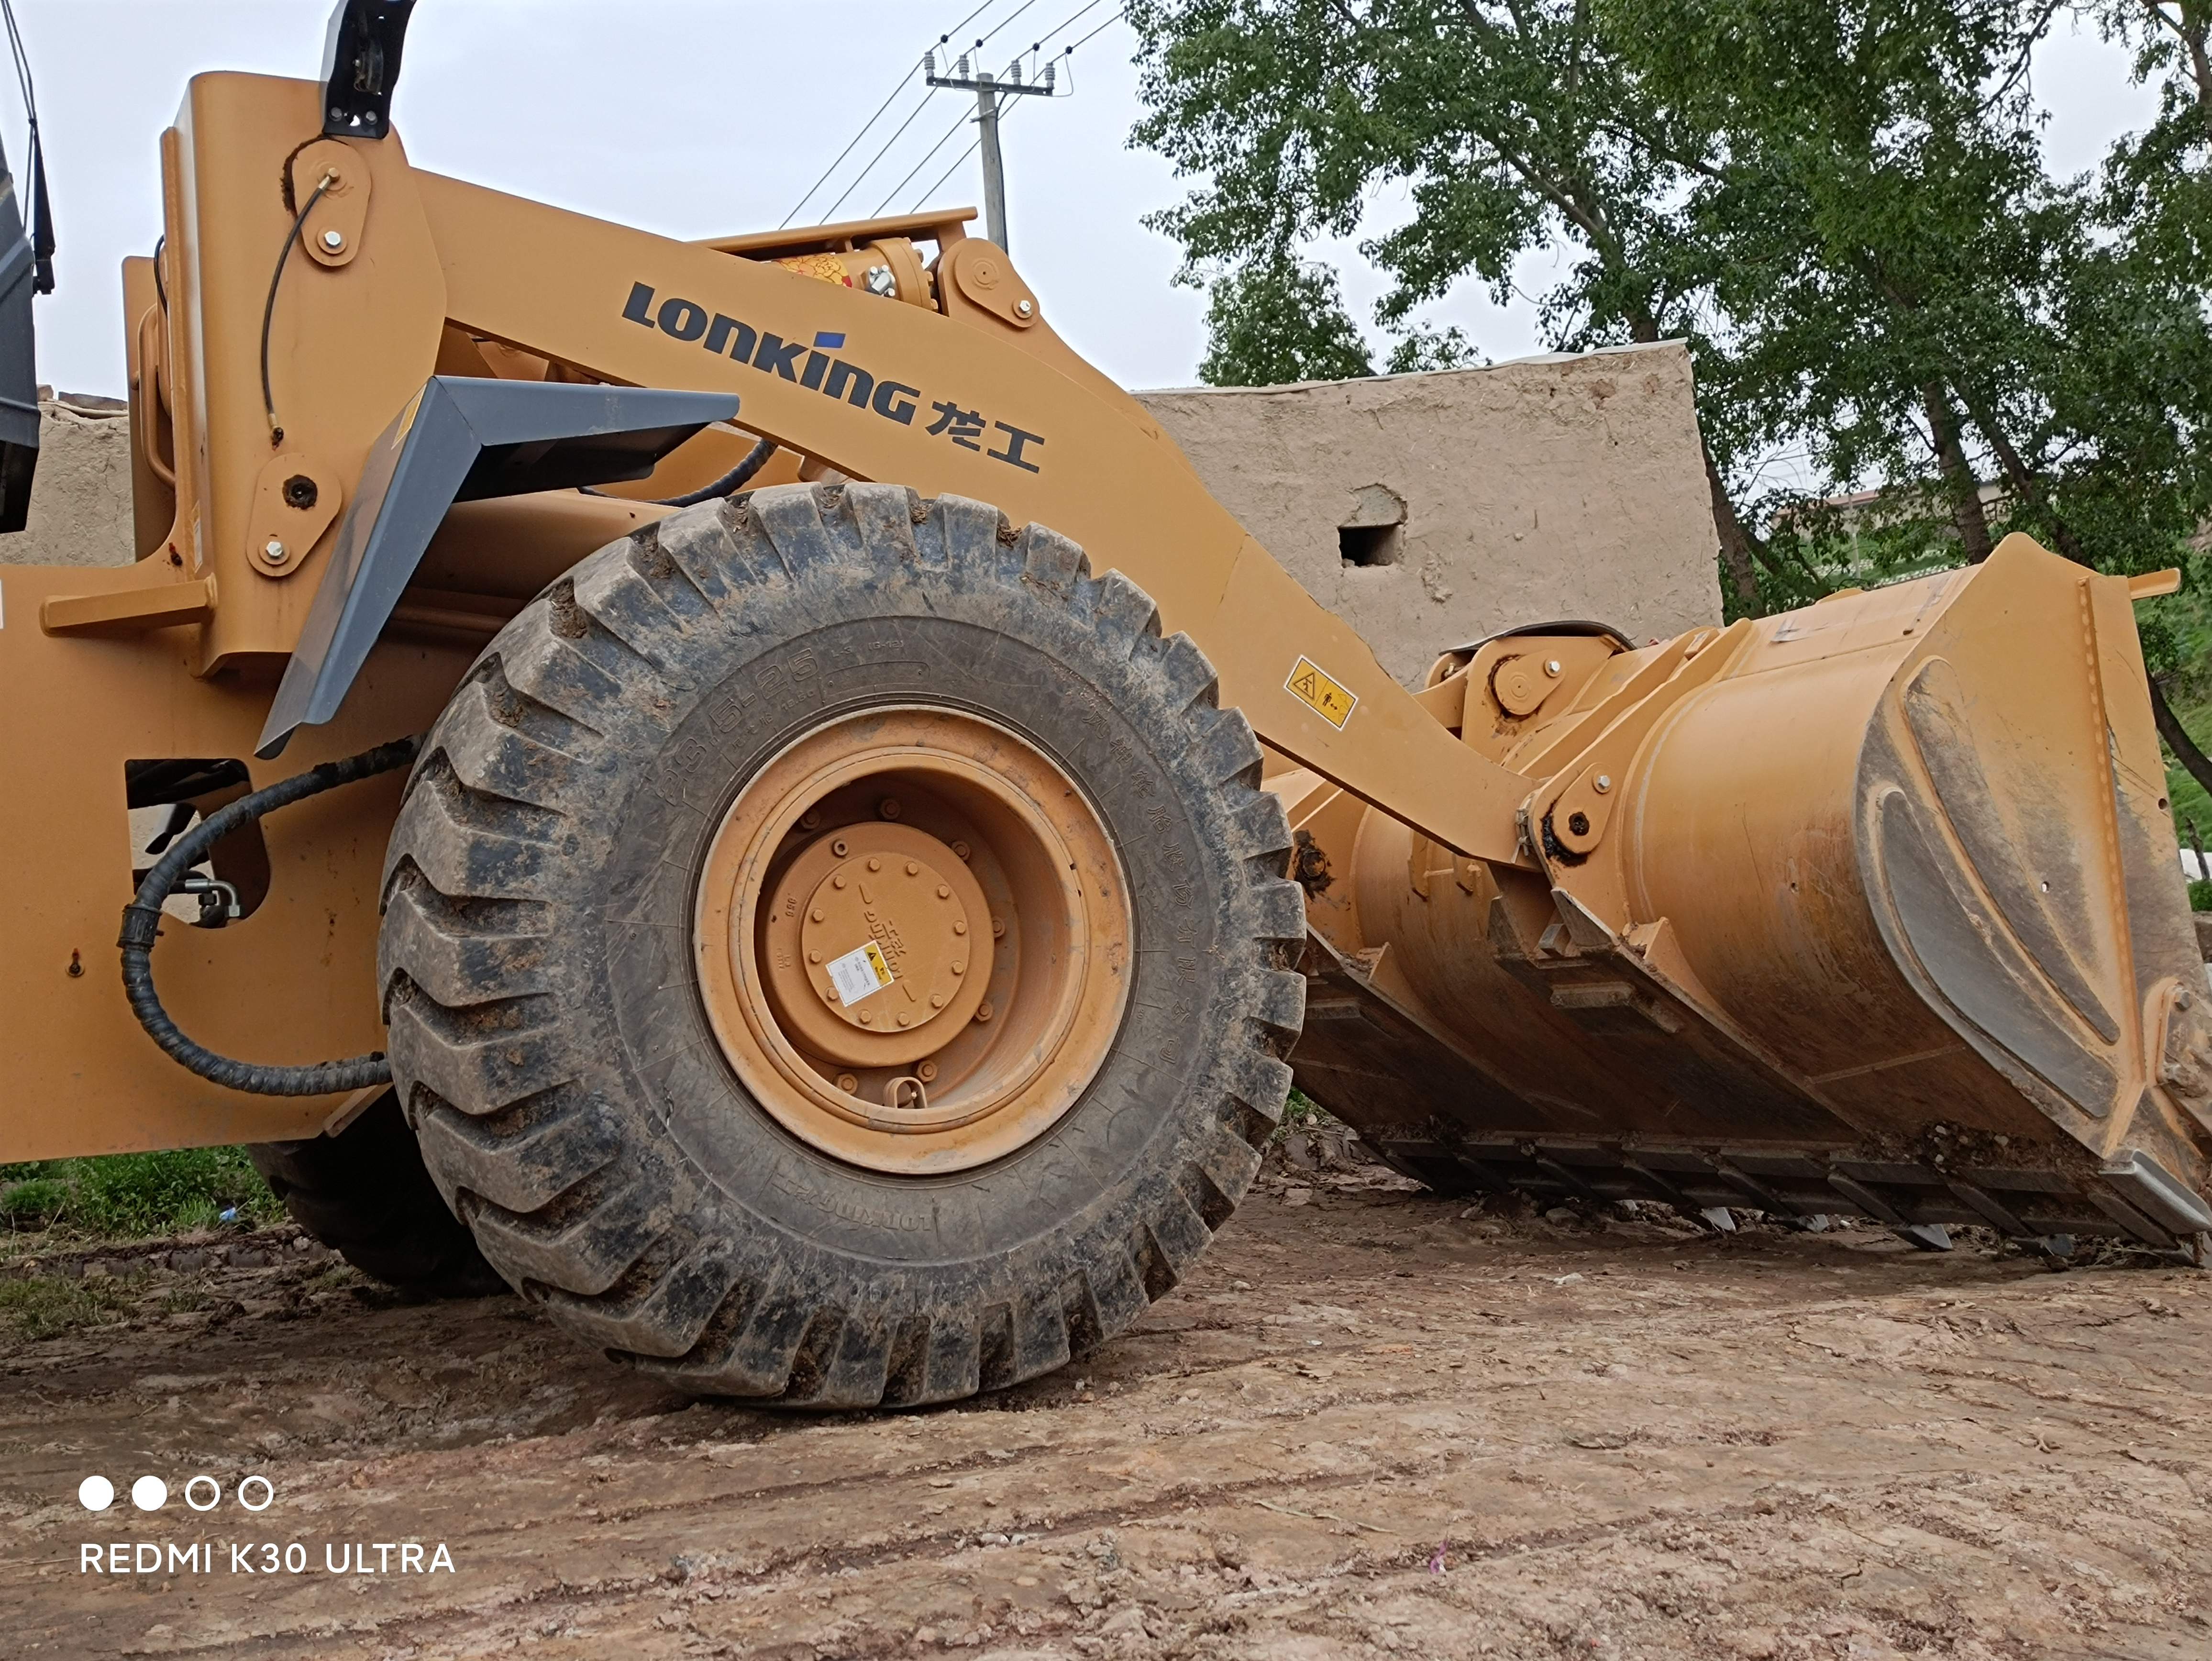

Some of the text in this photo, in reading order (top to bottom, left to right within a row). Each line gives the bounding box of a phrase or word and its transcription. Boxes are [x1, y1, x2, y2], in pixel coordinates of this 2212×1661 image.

[925, 401, 1045, 474] 龙工
[655, 648, 818, 807] 23.5-25
[1082, 710, 1197, 1065] 风神轮胎股份有限公司
